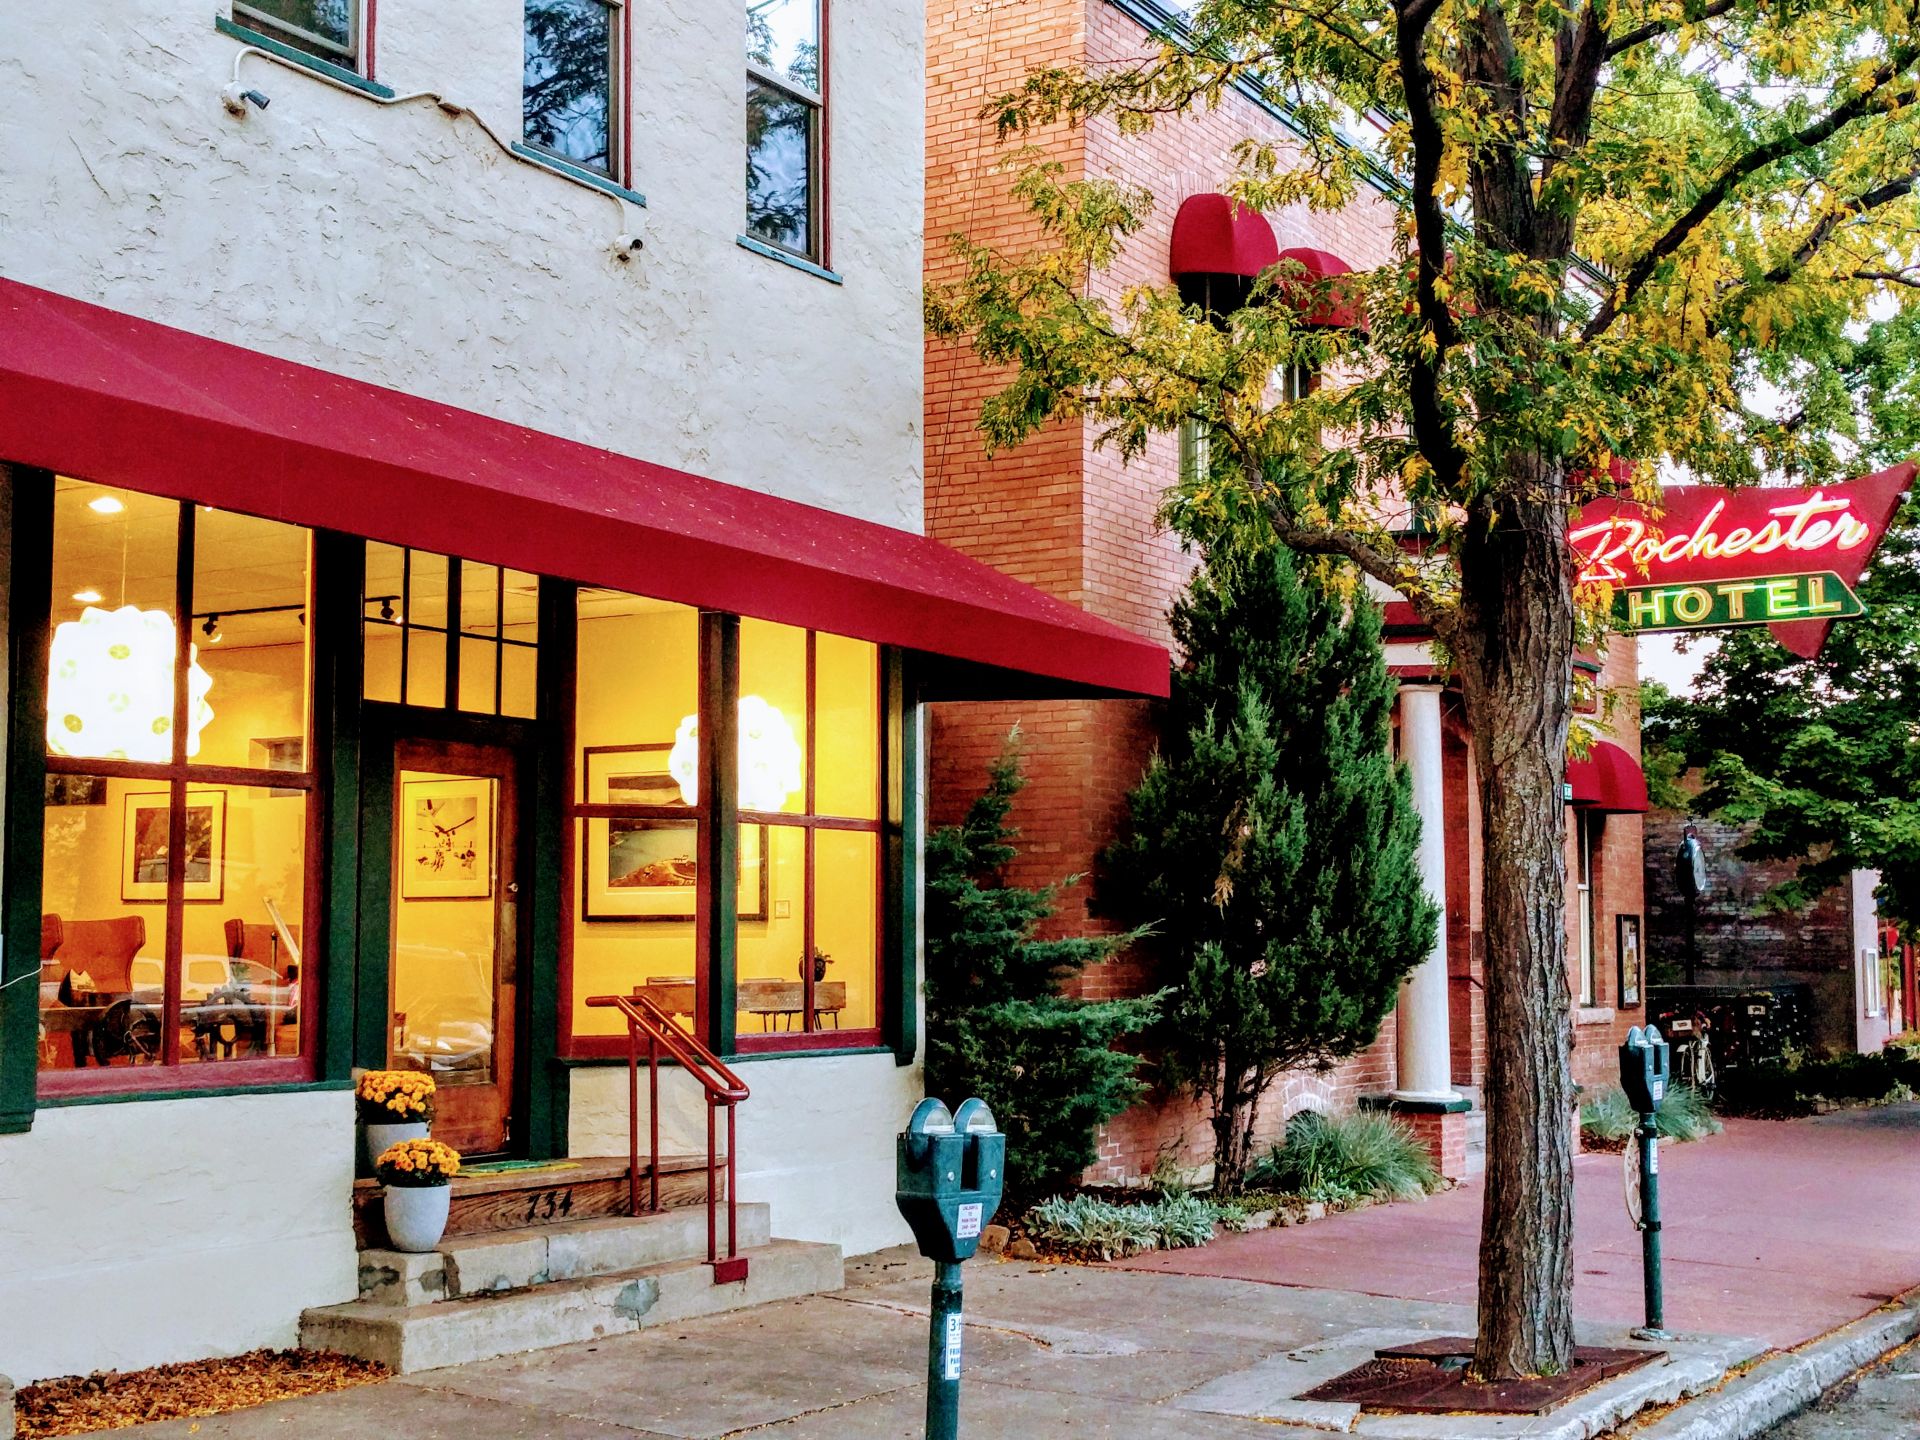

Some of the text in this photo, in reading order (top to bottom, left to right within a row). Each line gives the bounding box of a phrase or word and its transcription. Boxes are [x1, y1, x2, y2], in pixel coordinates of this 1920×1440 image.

[1569, 492, 1870, 581] Rochester
[1629, 576, 1843, 626] HOTEL
[526, 1188, 573, 1223] 734
